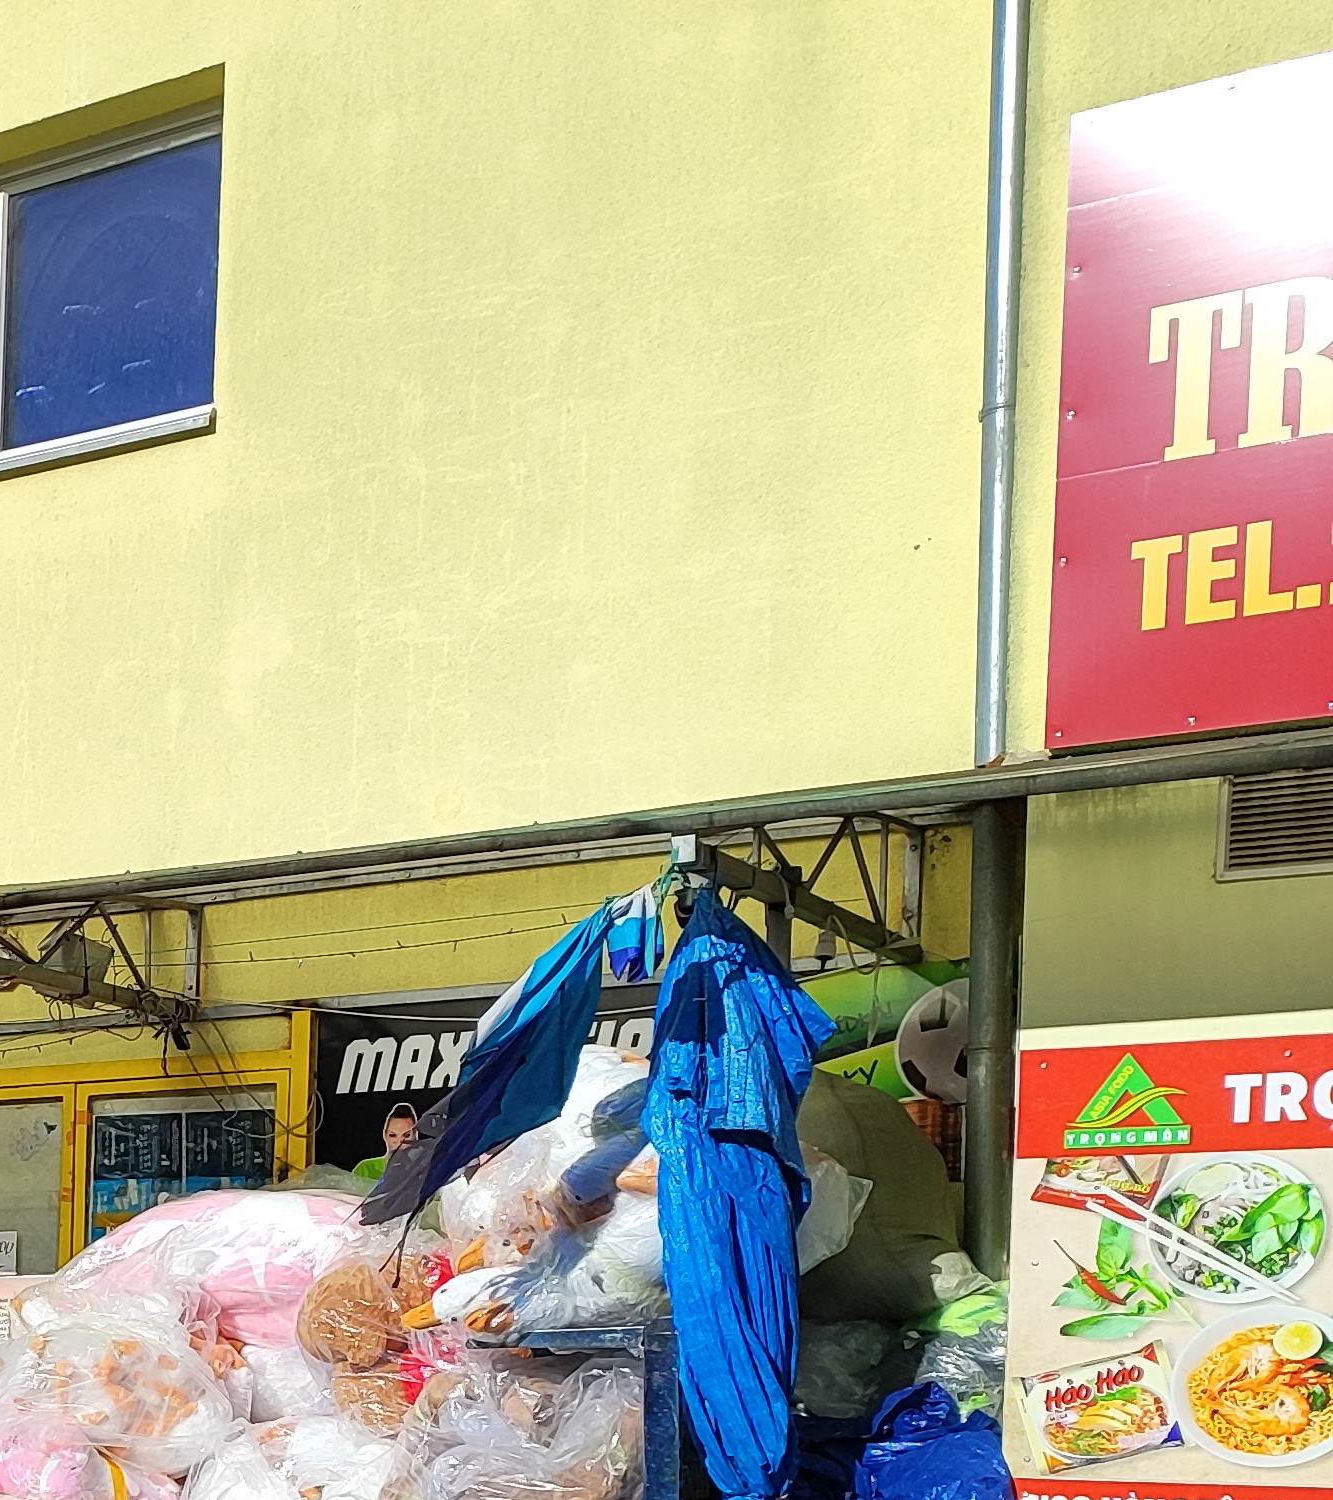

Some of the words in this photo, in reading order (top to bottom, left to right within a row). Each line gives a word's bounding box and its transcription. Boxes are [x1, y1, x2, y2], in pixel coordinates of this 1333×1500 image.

[1089, 1095, 1113, 1119] ASIA
[1107, 1065, 1135, 1095] FOOD
[1044, 1378, 1093, 1412] Hảo
[1095, 1359, 1145, 1394] Hảo
